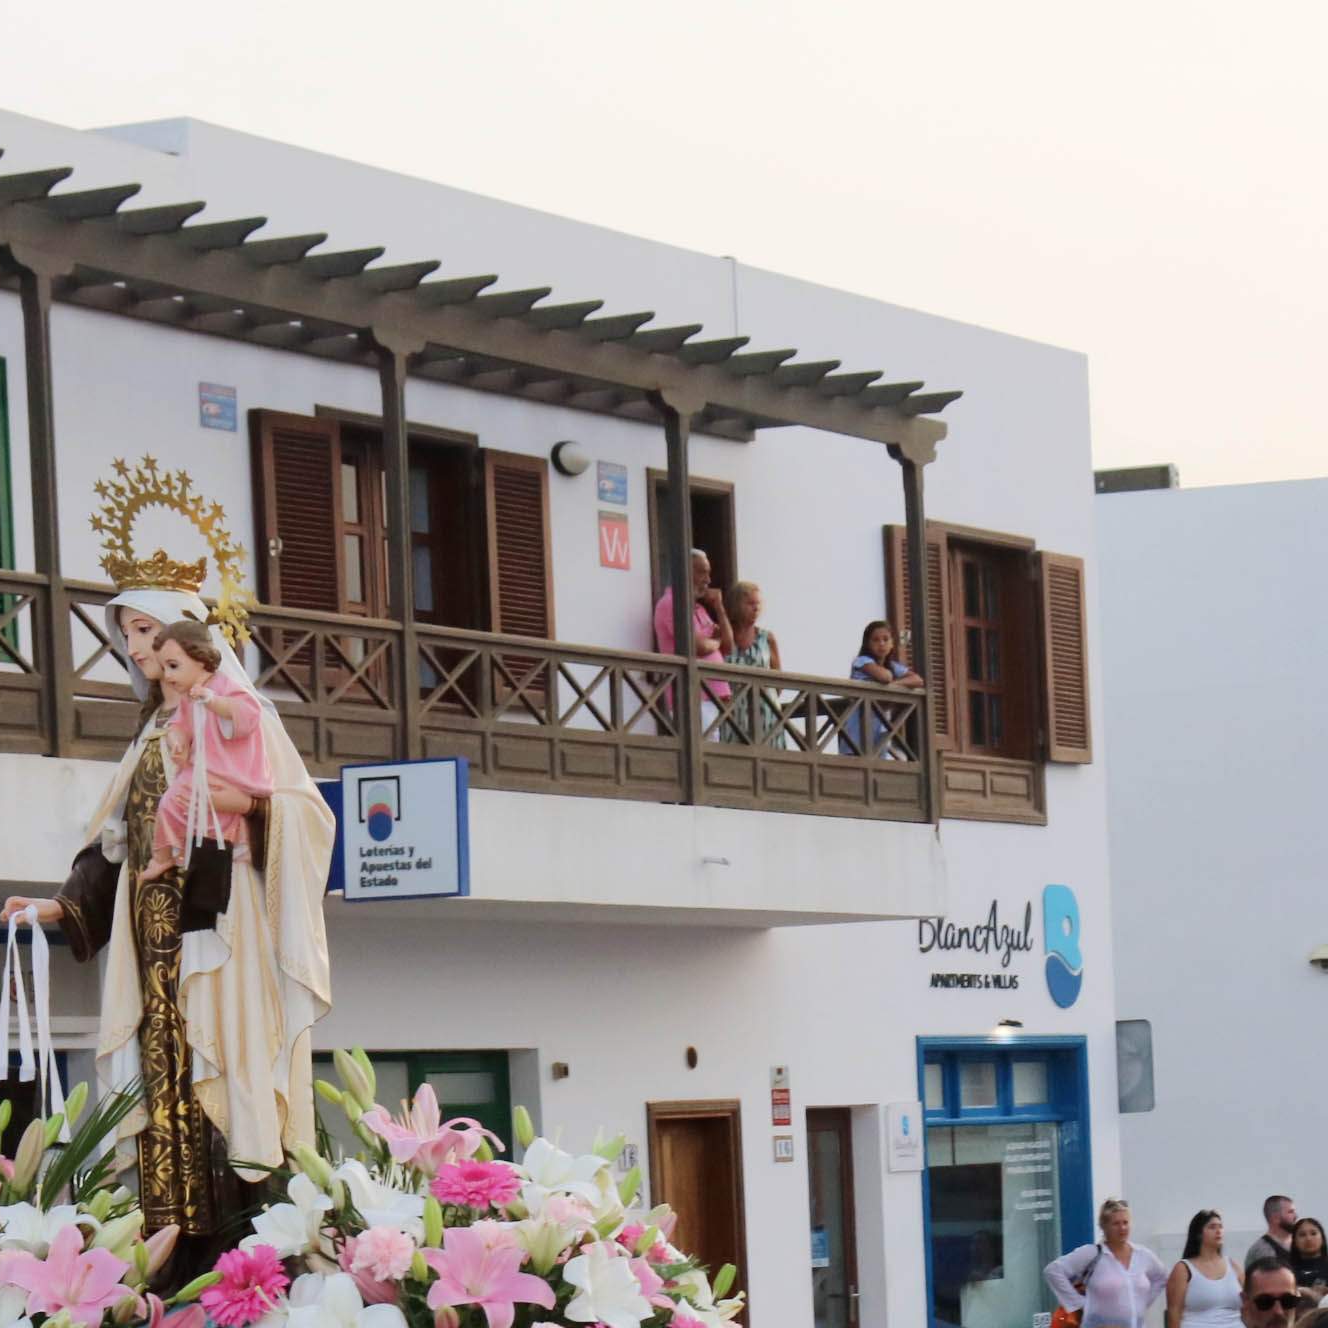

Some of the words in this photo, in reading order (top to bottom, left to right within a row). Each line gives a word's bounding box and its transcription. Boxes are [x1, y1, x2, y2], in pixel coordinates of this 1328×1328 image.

[359, 842, 405, 858] Loterías
[408, 845, 415, 858] y
[360, 859, 412, 875] Apuestas
[415, 856, 432, 870] del
[360, 874, 398, 888] Estado
[929, 973, 983, 989] APARTMENTS
[992, 974, 1020, 990] VILLAS
